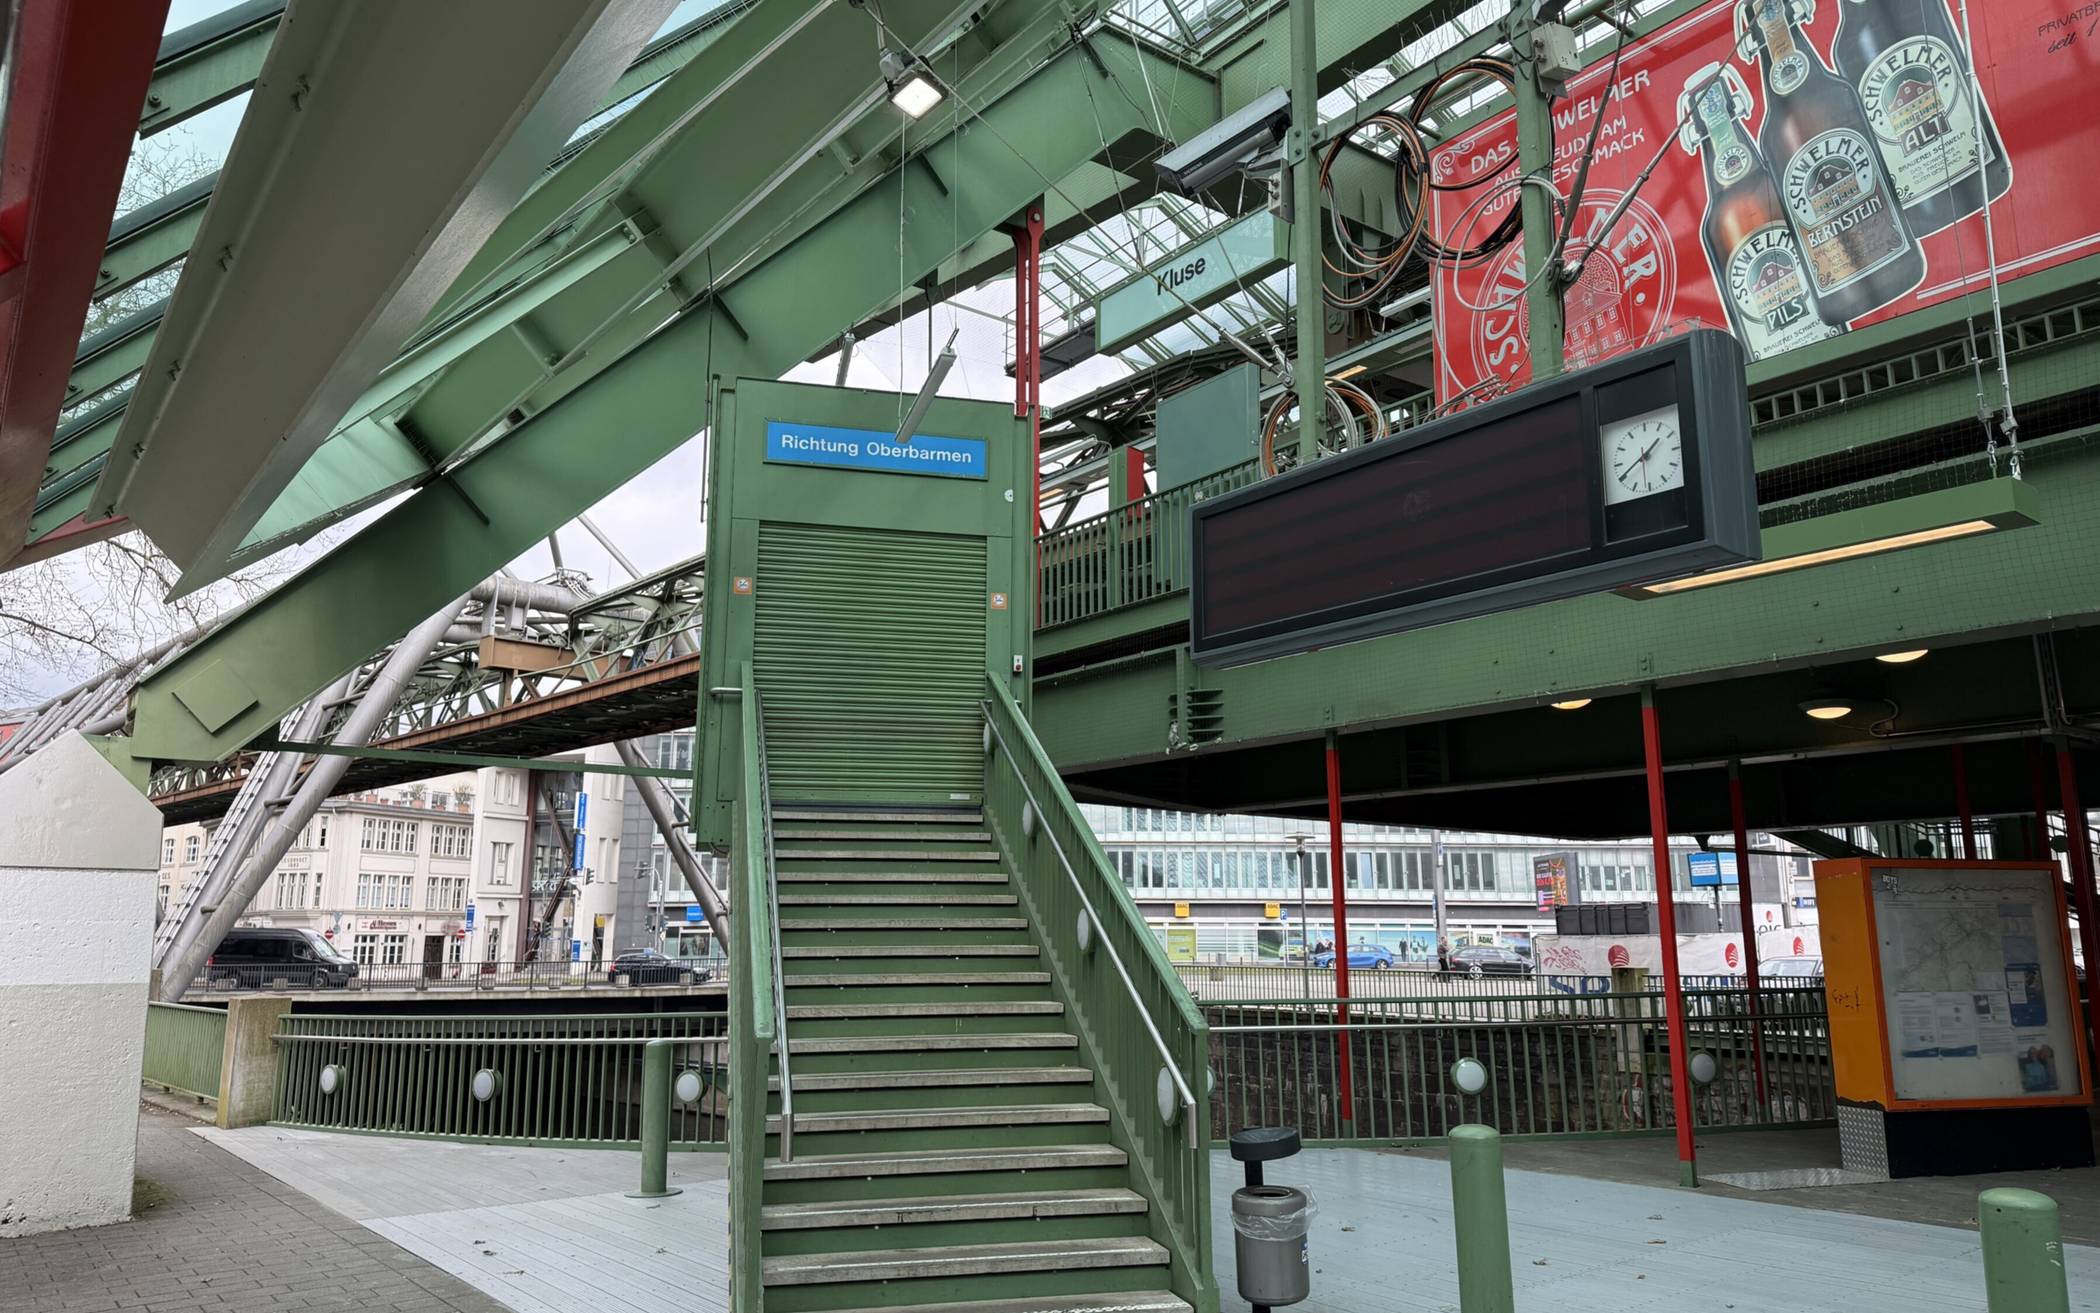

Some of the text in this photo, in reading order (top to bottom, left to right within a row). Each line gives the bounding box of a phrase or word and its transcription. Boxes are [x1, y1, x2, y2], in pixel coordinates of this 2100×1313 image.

[1865, 45, 1952, 123] SCHWELMER
[1601, 115, 1627, 140] AM
[1904, 111, 1946, 152] ALT
[1471, 138, 1512, 175] DAS
[1790, 137, 1870, 210] SCHWELMER
[1807, 195, 1883, 248] BERNSTEIN
[1157, 257, 1206, 296] Kluse
[1766, 298, 1804, 330] PILS
[782, 434, 972, 463] Richtung Oberbarmen
[1478, 935, 1495, 946] ADAC
